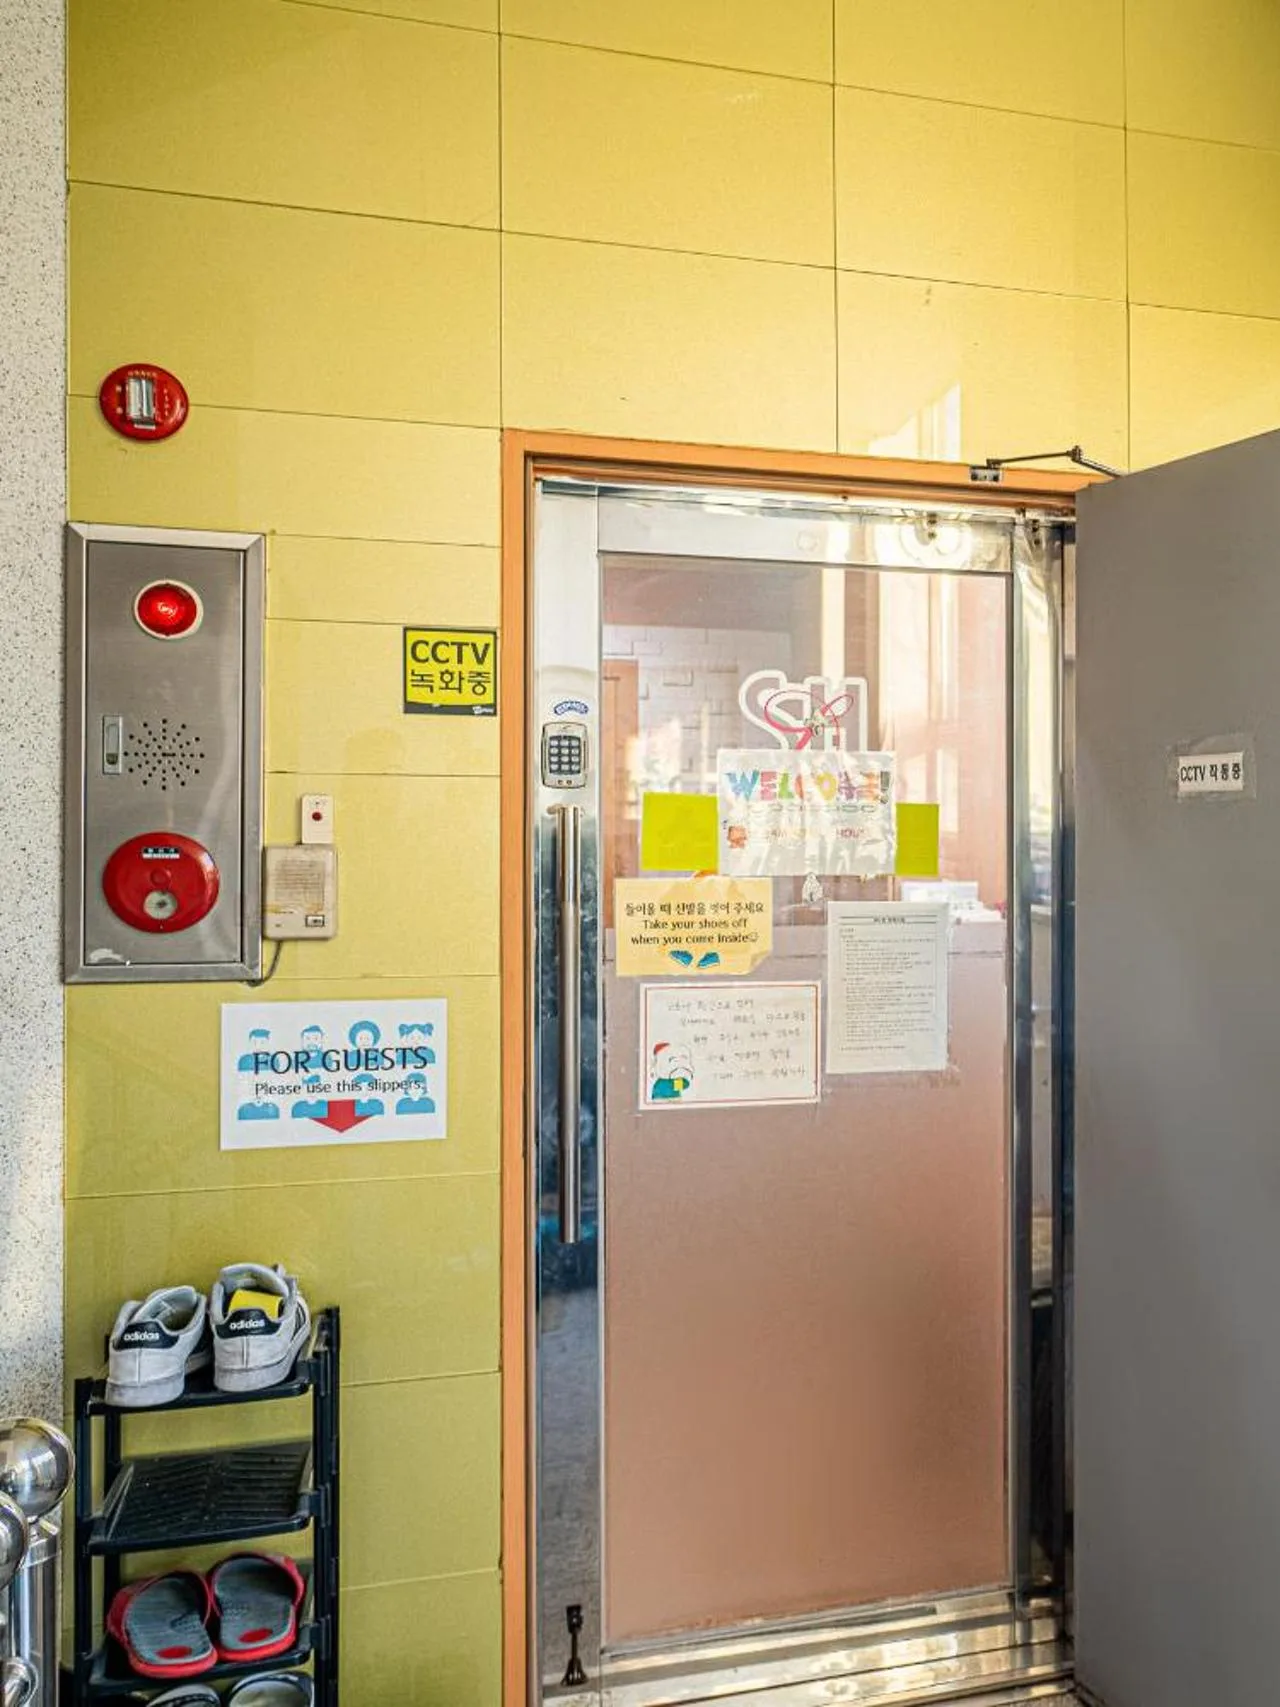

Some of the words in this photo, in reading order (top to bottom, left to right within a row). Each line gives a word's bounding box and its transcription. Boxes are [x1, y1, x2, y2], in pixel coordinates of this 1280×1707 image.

[410, 640, 490, 665] CCTV
[410, 669, 491, 696] 녹화중
[1180, 764, 1206, 781] CCTV
[733, 901, 764, 914] 주세요
[643, 919, 669, 929] Take
[671, 920, 695, 931] your
[699, 918, 730, 929] shoes
[732, 918, 748, 928] off
[631, 934, 660, 945] when
[663, 935, 683, 946] you
[685, 935, 715, 944] come
[253, 1050, 311, 1075] FOR
[321, 1046, 428, 1073] GUESTS
[255, 1082, 302, 1096] Please
[307, 1083, 332, 1094] use
[336, 1080, 363, 1093] this
[229, 1318, 266, 1330] adidas
[123, 1331, 160, 1342] adidas
